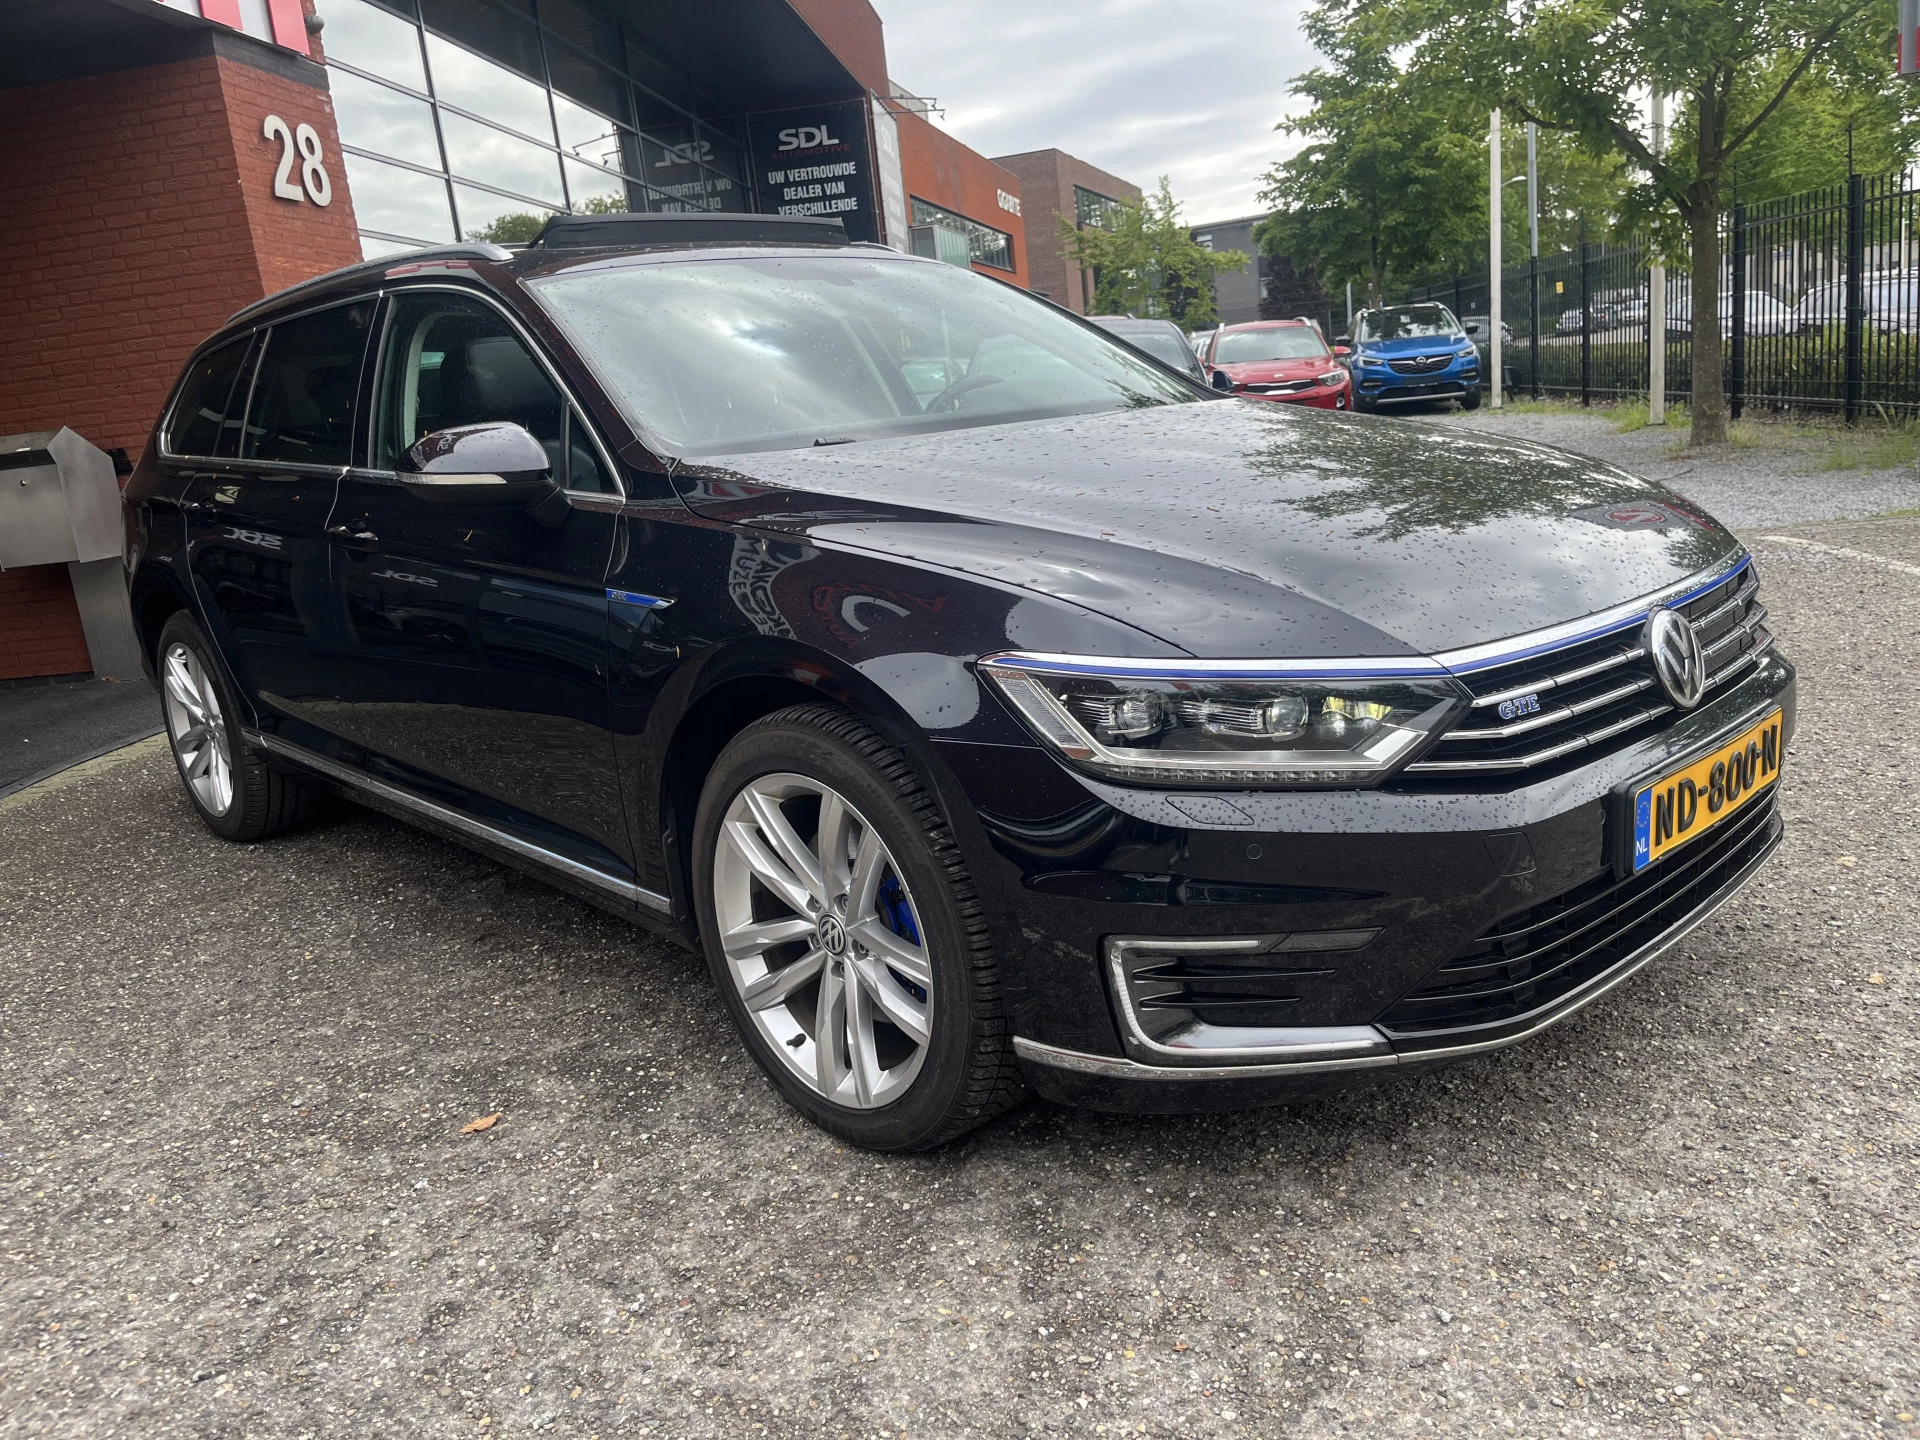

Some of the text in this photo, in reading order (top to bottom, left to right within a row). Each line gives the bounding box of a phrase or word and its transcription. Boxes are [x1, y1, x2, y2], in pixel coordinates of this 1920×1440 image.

[778, 125, 839, 150] SDL
[263, 114, 332, 207] 28
[771, 144, 851, 159] AUTOMOTIVE
[768, 162, 857, 184] UW VERTROUWDE
[784, 181, 845, 200] DEALER VAN
[778, 198, 858, 216] VERSCHILLENDE
[1498, 694, 1541, 719] GTE
[1655, 723, 1778, 847] ND-800-N
[1636, 837, 1648, 856] NL
